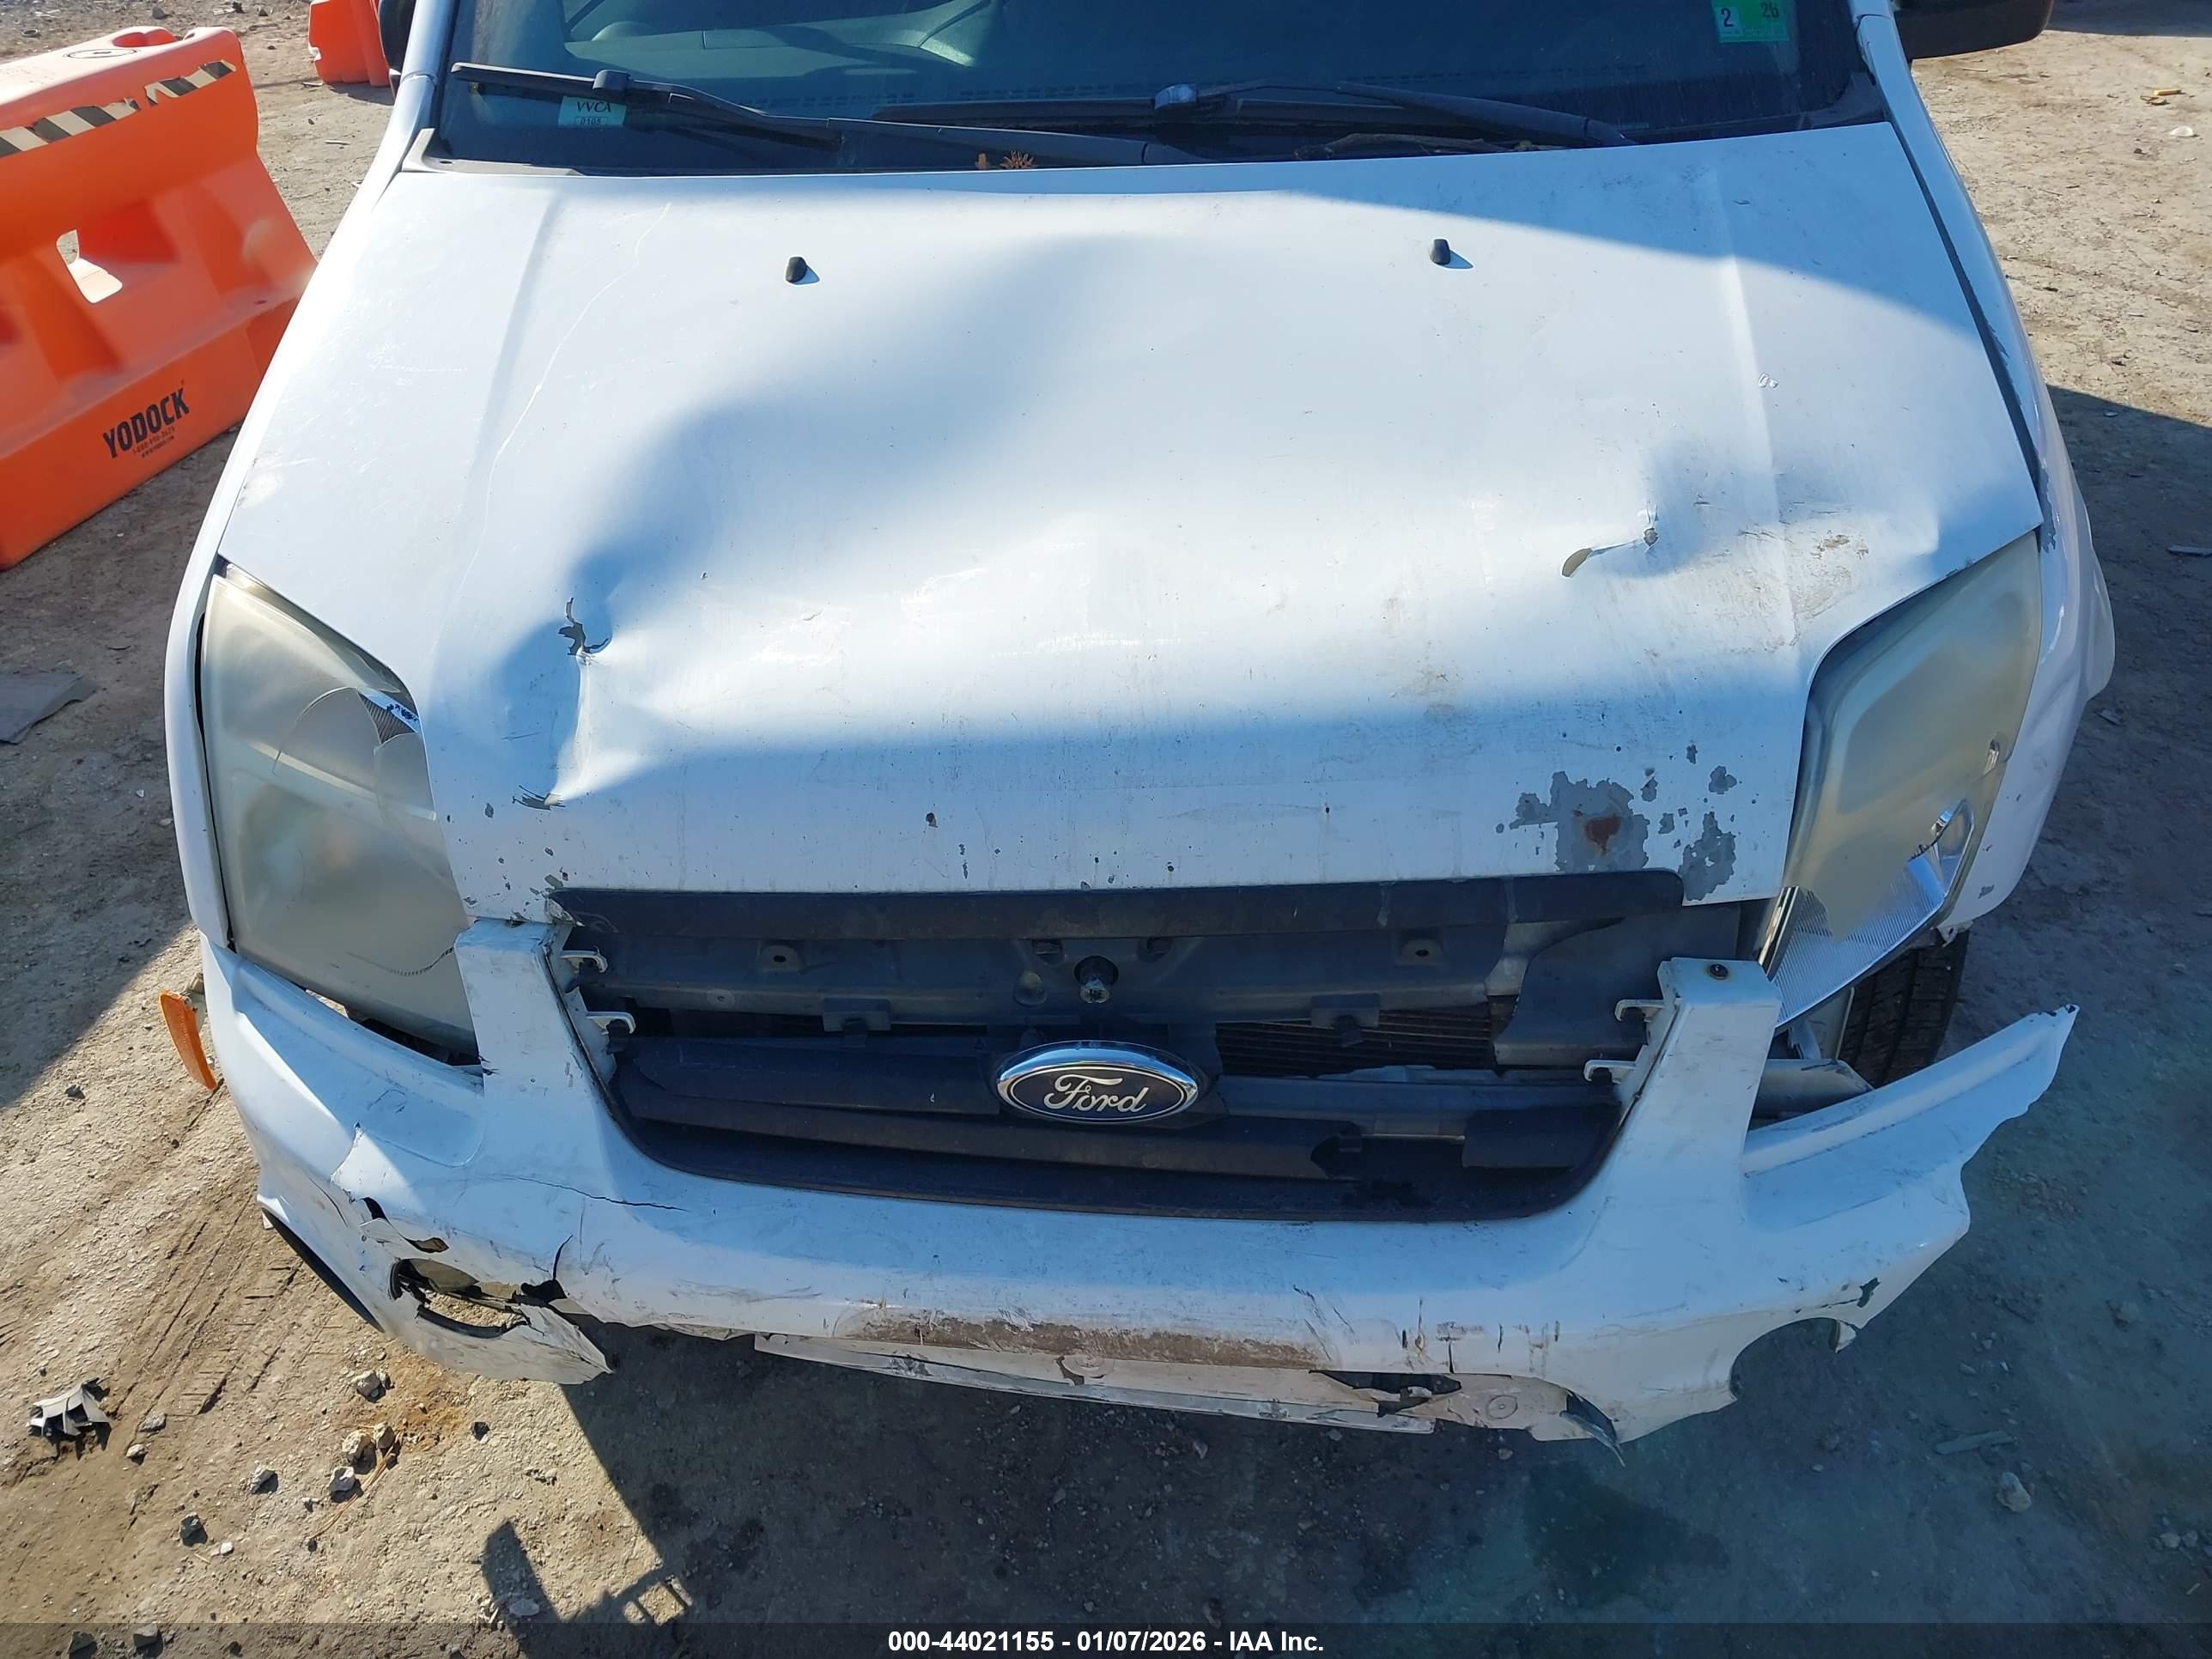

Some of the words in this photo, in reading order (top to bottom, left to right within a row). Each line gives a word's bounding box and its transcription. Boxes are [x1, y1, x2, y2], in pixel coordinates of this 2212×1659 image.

[1720, 7, 1734, 27] 2
[102, 387, 190, 459] YODOCK
[1043, 1073, 1150, 1113] Ford
